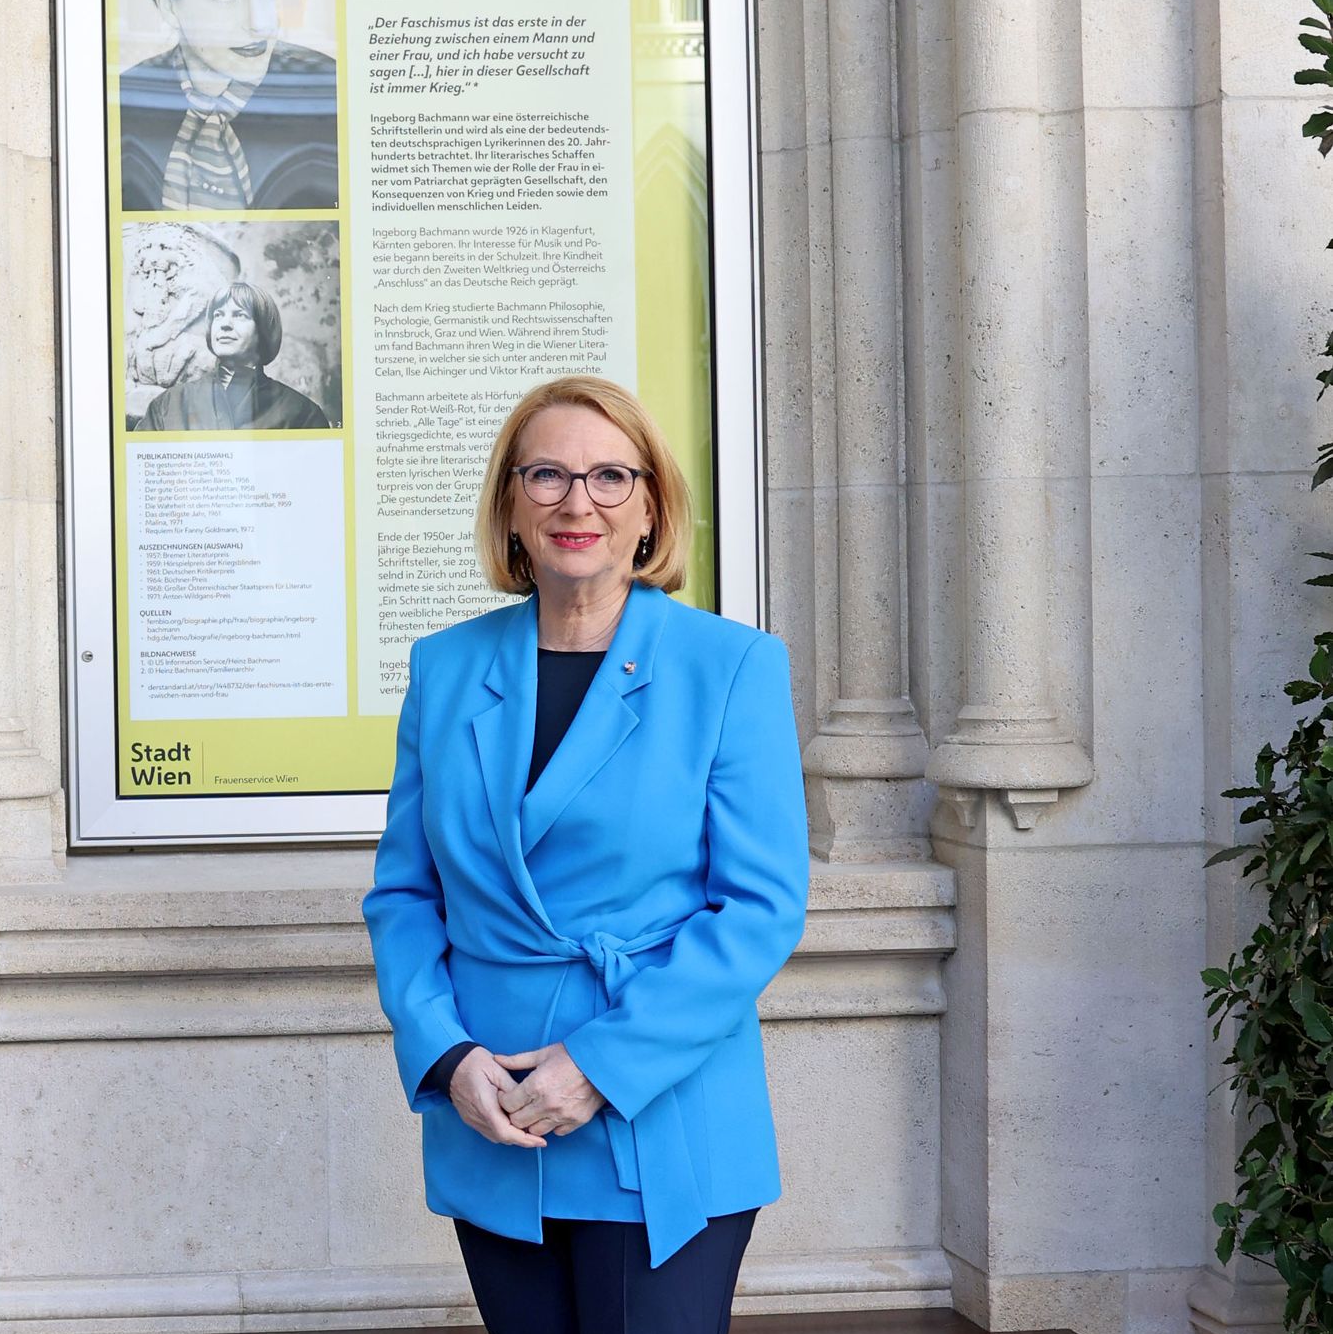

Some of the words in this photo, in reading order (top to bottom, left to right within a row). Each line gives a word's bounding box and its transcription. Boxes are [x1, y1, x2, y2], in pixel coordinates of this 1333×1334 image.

[401, 17, 470, 28] Faschismus
[474, 17, 489, 27] ist
[492, 16, 513, 27] das
[518, 17, 548, 27] erste
[551, 16, 562, 27] in
[566, 16, 586, 27] der
[369, 33, 431, 47] Beziehung
[435, 33, 489, 44] zwischen
[493, 33, 529, 43] einem
[533, 33, 568, 43] Mann
[572, 32, 595, 43] und
[369, 50, 400, 61] einer
[403, 49, 432, 62] Frau,
[437, 49, 460, 60] und
[463, 49, 480, 60] ich
[483, 49, 514, 60] habe
[517, 48, 569, 59] versucht
[369, 69, 406, 80] sagen
[436, 65, 459, 77] hier
[462, 65, 473, 76] in
[477, 65, 513, 76] dieser
[517, 64, 589, 76] Gesellschaft
[370, 83, 385, 93] ist
[387, 83, 427, 93] immer
[371, 113, 415, 125] Ingeborg
[419, 113, 469, 122] Bachmann
[493, 113, 513, 121] eine
[516, 112, 589, 121] österreichische
[371, 126, 442, 135] Schriftstellerin
[445, 125, 463, 135] und
[466, 125, 487, 134] wird
[491, 125, 503, 134] als
[506, 125, 526, 134] eine
[529, 125, 545, 134] der
[548, 125, 609, 133] bedeutends-
[372, 202, 435, 211] individuellen
[437, 201, 503, 211] menschlichen
[507, 201, 541, 210] Leiden.
[373, 227, 417, 238] Ingeborg
[419, 227, 470, 236] Bachmann
[472, 227, 503, 235] wurde
[506, 226, 528, 235] 1926
[531, 227, 539, 235] in
[542, 226, 595, 237] Klagenfurt,
[375, 367, 403, 377] Celan,
[406, 367, 421, 376] Ilse
[423, 366, 467, 377] Aichinger
[469, 366, 487, 375] und
[490, 366, 518, 375] Viktor
[521, 365, 543, 374] Kraft
[546, 365, 603, 374] austauschte.
[377, 506, 477, 517] Auseinandersetzung
[131, 742, 191, 762] Stadt
[131, 766, 191, 785] Wien
[215, 776, 274, 784] Frauenservice
[276, 775, 298, 783] Wien
